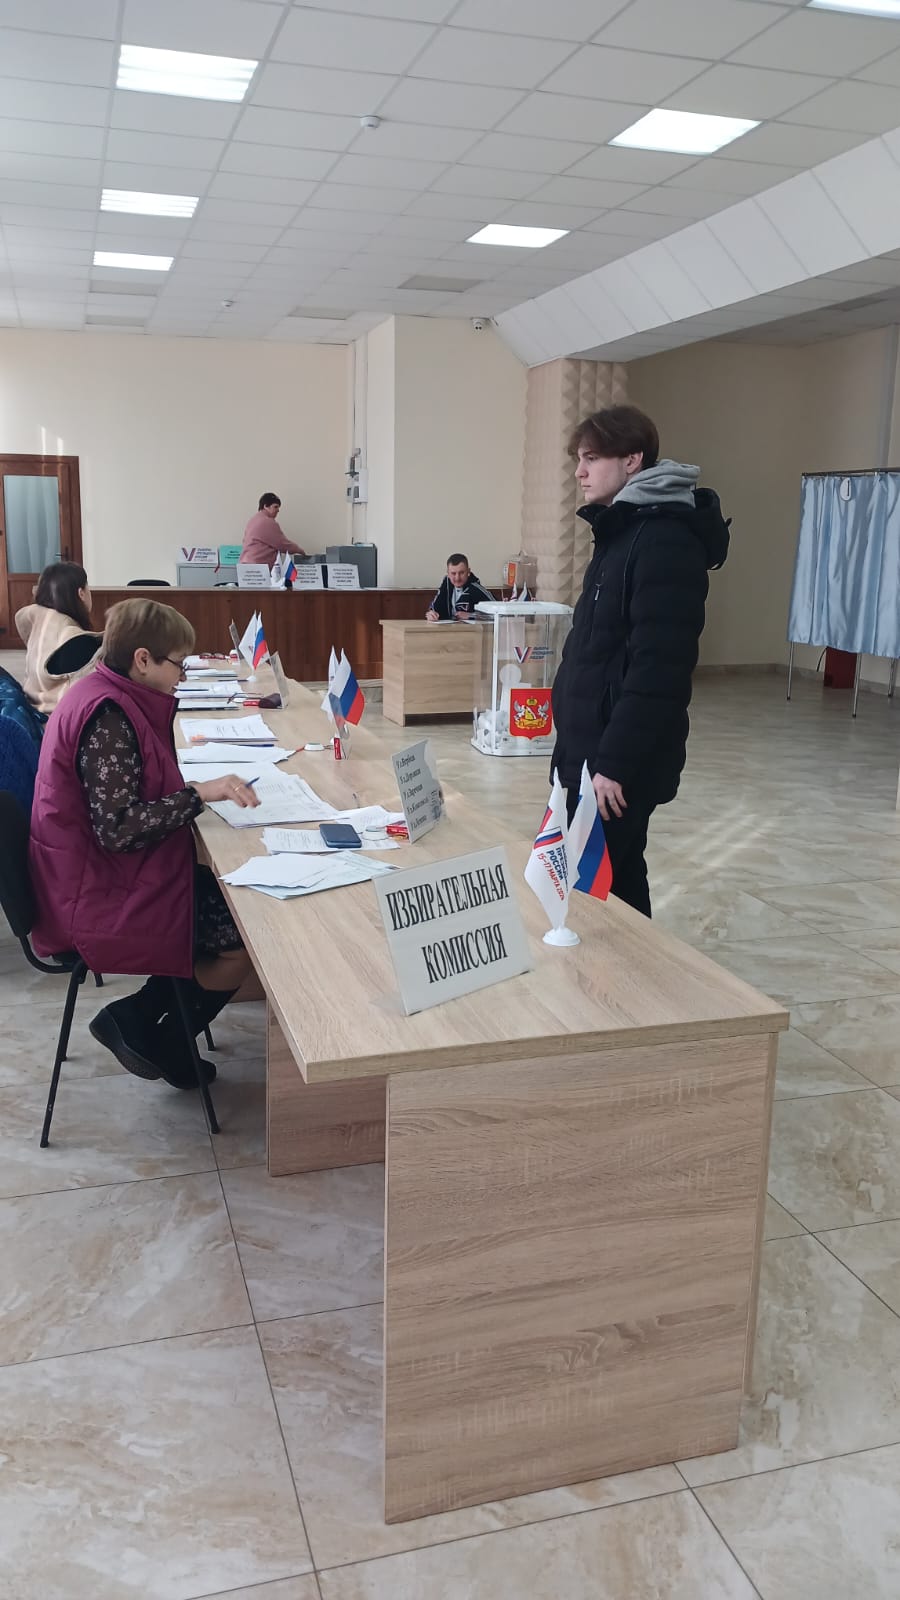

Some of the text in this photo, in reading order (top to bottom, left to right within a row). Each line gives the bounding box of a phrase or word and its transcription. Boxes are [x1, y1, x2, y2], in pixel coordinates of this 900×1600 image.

[546, 850, 564, 881] РОССИИ
[547, 868, 561, 888] МАРТА
[385, 864, 510, 931] ИЗБИРАТЕЛЬНАЯ
[421, 923, 508, 984] КОМИССИЯ
